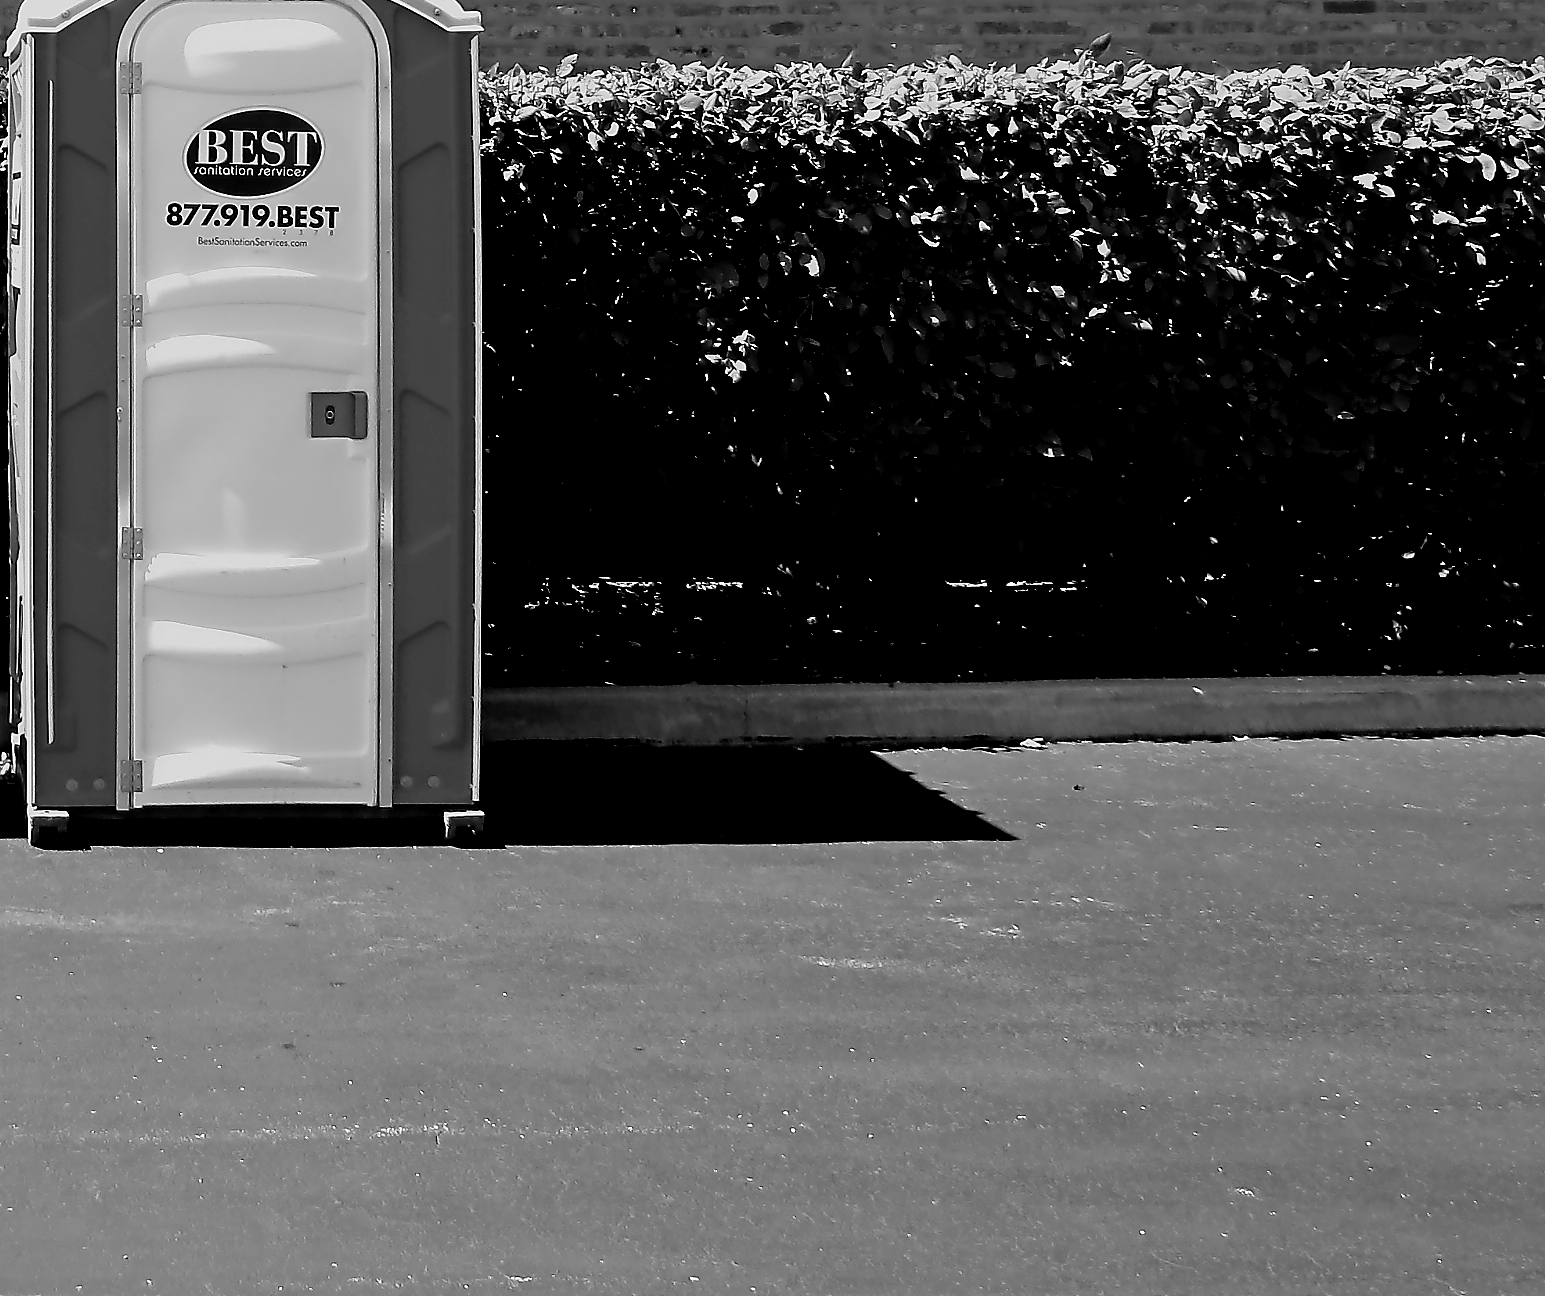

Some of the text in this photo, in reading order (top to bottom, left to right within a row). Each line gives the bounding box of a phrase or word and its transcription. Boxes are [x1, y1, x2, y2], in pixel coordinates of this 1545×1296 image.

[195, 129, 318, 167] BEST
[193, 164, 307, 177] sanitation services
[166, 203, 340, 229] 877.919.BEST
[197, 236, 308, 247] BestSanitationServices.com
